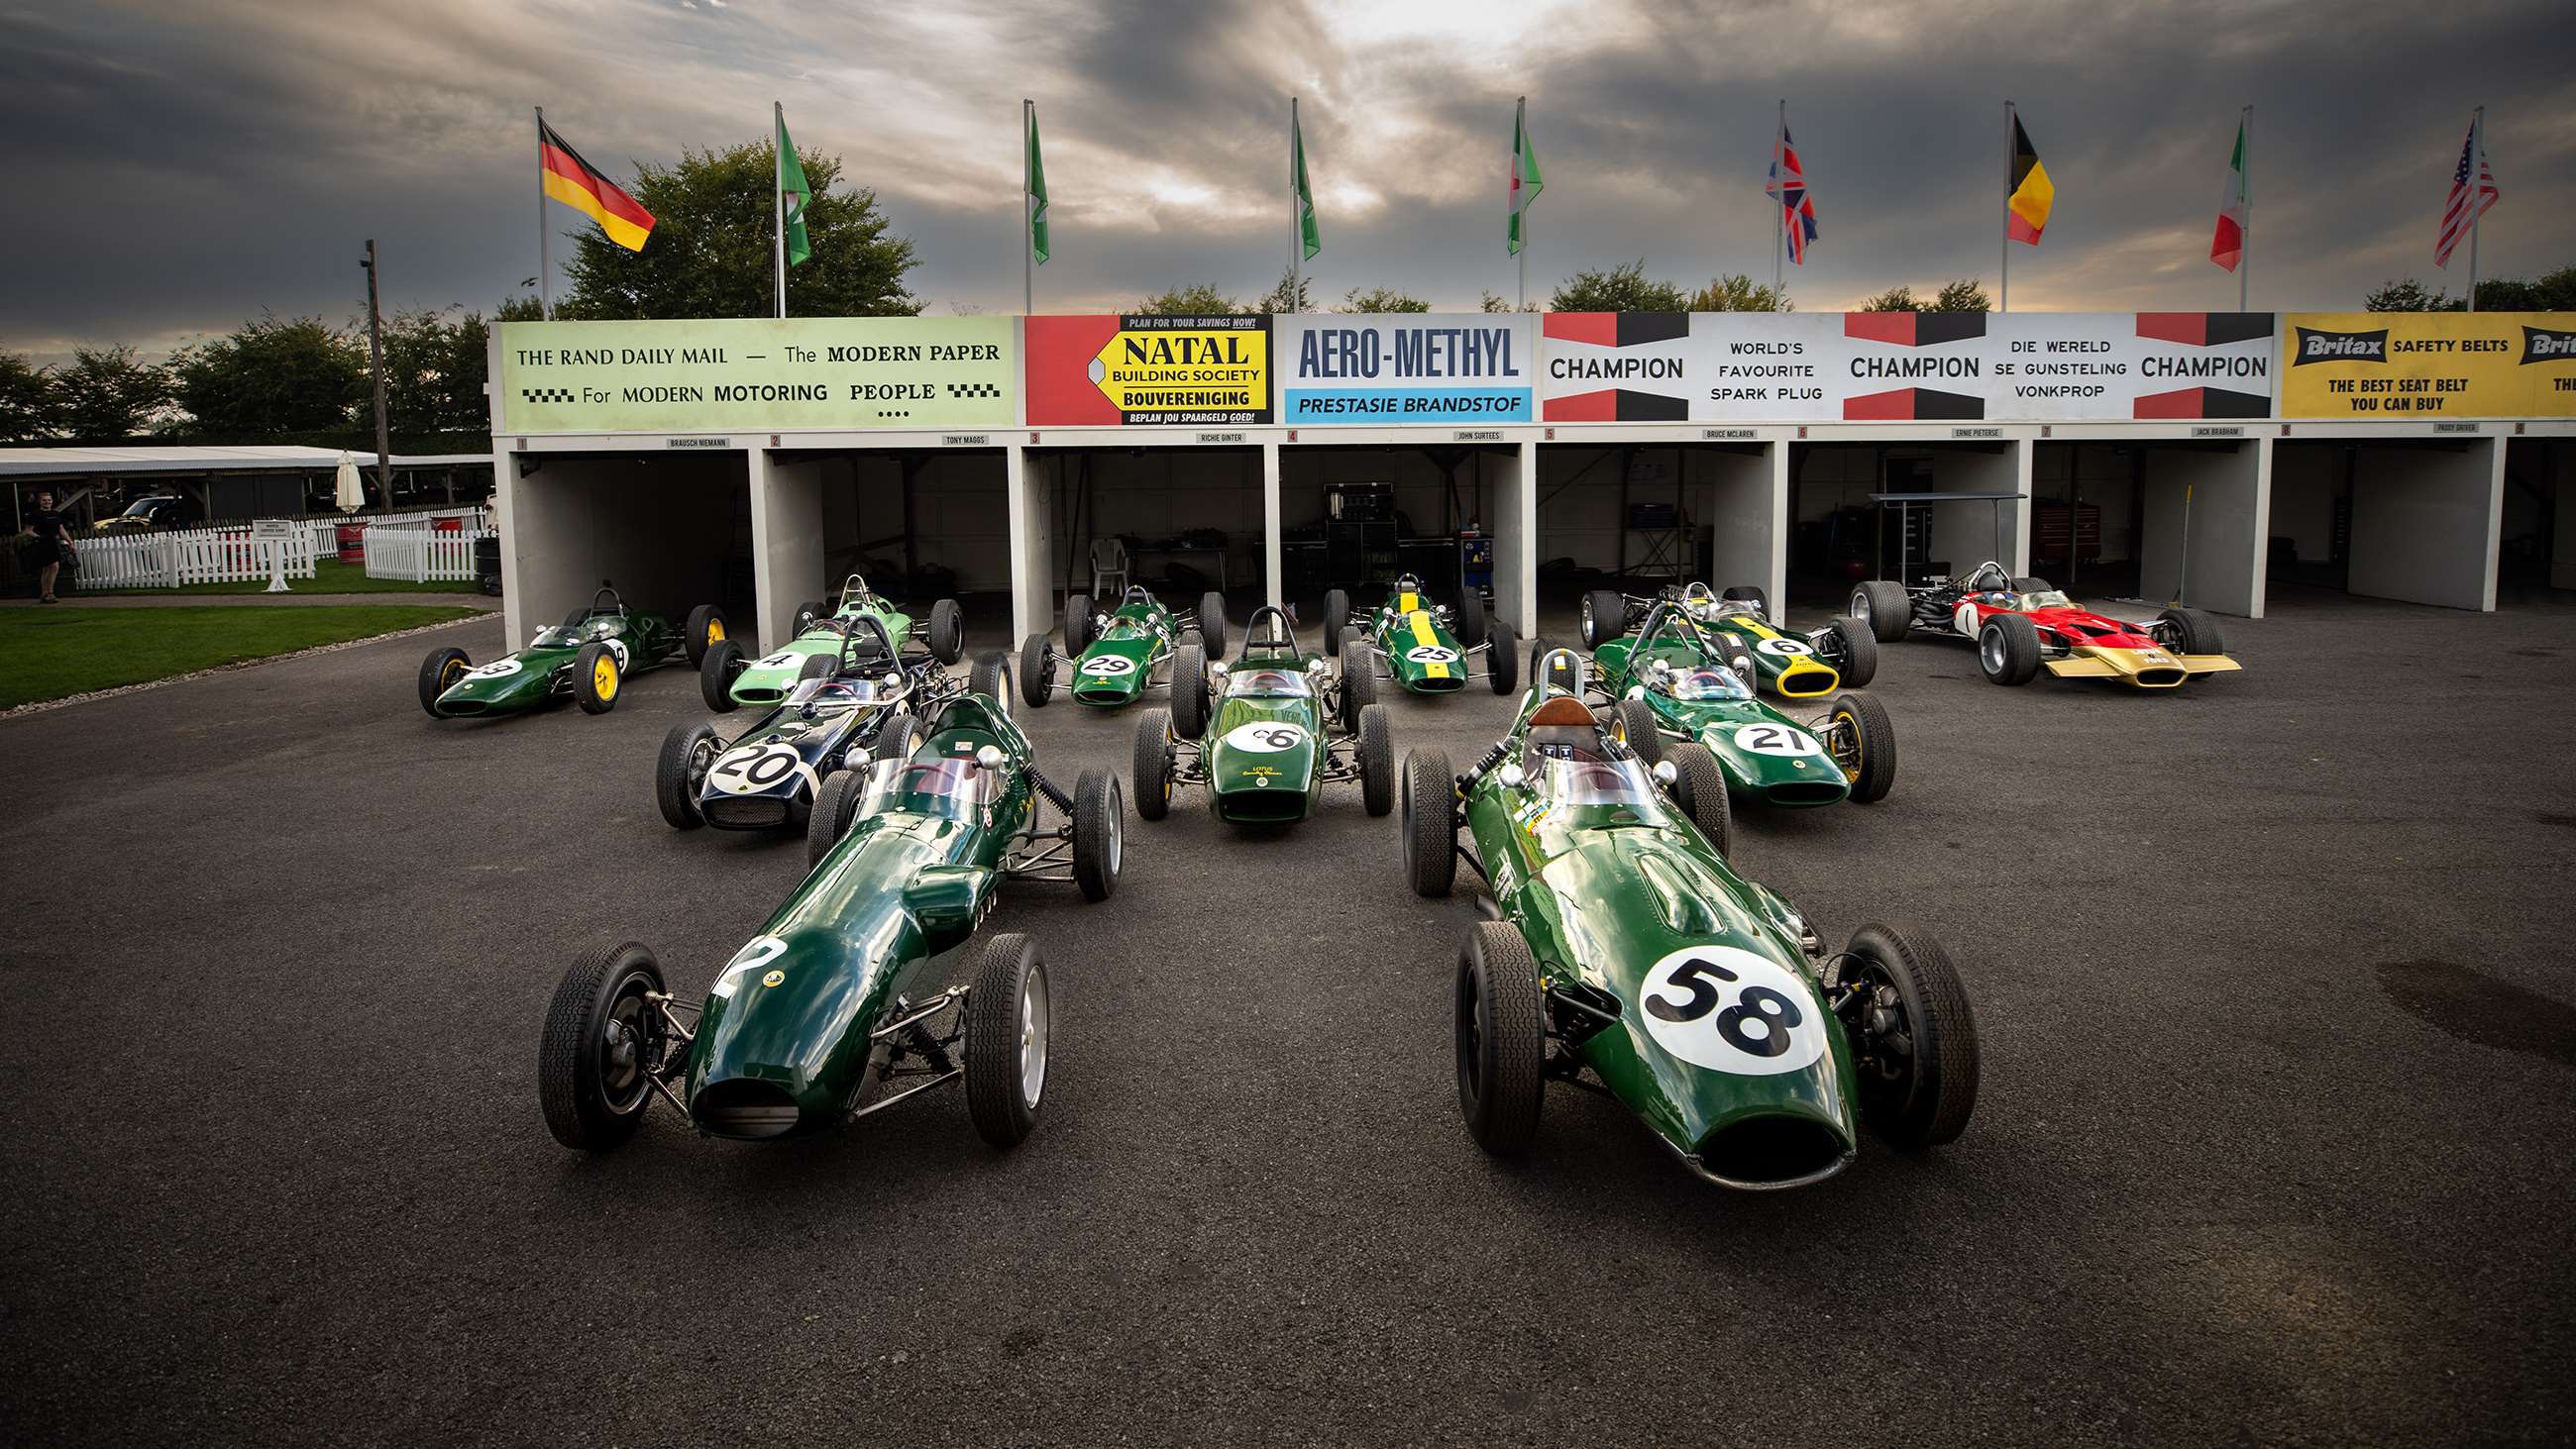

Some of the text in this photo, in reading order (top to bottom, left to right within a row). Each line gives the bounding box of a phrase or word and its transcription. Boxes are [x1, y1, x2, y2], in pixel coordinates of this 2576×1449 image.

[1129, 318, 1256, 328] PLAN FOR YOUR SAVINGS NOW!
[1124, 338, 1248, 364] NATAL
[1731, 344, 1802, 354] WORLD'S
[2012, 342, 2110, 353] DIE WERELD
[2307, 335, 2382, 355] Britax
[2394, 341, 2508, 352] SAFETY BELTS
[2532, 335, 2576, 355] Brit
[517, 351, 553, 365] THE
[561, 350, 613, 364] RAND
[622, 349, 674, 363] DAILY
[682, 349, 727, 363] MAIL
[785, 346, 815, 362] The
[827, 347, 921, 362] MODERN
[930, 346, 1000, 361] PAPER
[1298, 329, 1519, 378] AERO-METHYL
[1551, 359, 1682, 378] CHAMPION
[1720, 365, 1813, 376] FAVOURITE
[1851, 358, 1979, 377] CHAMPION
[1995, 363, 2126, 374] SE GUNSTELING
[2142, 358, 2266, 376] CHAMPION
[1113, 369, 1260, 381] BUILDING SOCIETY
[2015, 386, 2104, 397] VONKPROP
[2328, 379, 2468, 392] THE BEST SEAT BELT
[584, 384, 935, 403] For MODERN MOTORING PEOPLE
[1124, 391, 1249, 406] BOUVERENIGING
[1711, 388, 1822, 399] SPARK PLUG
[1299, 397, 1521, 413] PRESTASIE BRANDSTOF
[2351, 397, 2444, 410] YOU CAN BUY
[1129, 412, 1254, 424] BEPLAN JOU SPAARGELD GOED!
[1289, 431, 1296, 442] 4
[1458, 432, 1473, 441] JOHN
[1547, 429, 1553, 440] 5
[1707, 430, 1726, 439] BRUCE
[1799, 427, 1806, 438] 6
[1974, 428, 1998, 437] PIETERSE
[2044, 426, 2050, 437] 7
[2283, 425, 2290, 436] 8
[521, 439, 525, 449] 1
[670, 438, 726, 448] BRAUSCH NIEMANN
[772, 436, 779, 446] 2
[946, 436, 962, 445] TONY
[1031, 434, 1038, 444] 3
[1966, 609, 1971, 633] 1
[1772, 640, 1802, 654] 6
[1410, 647, 1453, 661] 25
[762, 654, 792, 667] 4
[1085, 657, 1129, 673] 29
[1750, 727, 1805, 751] 21
[713, 744, 798, 785] 20
[1644, 958, 1802, 1058] 58
